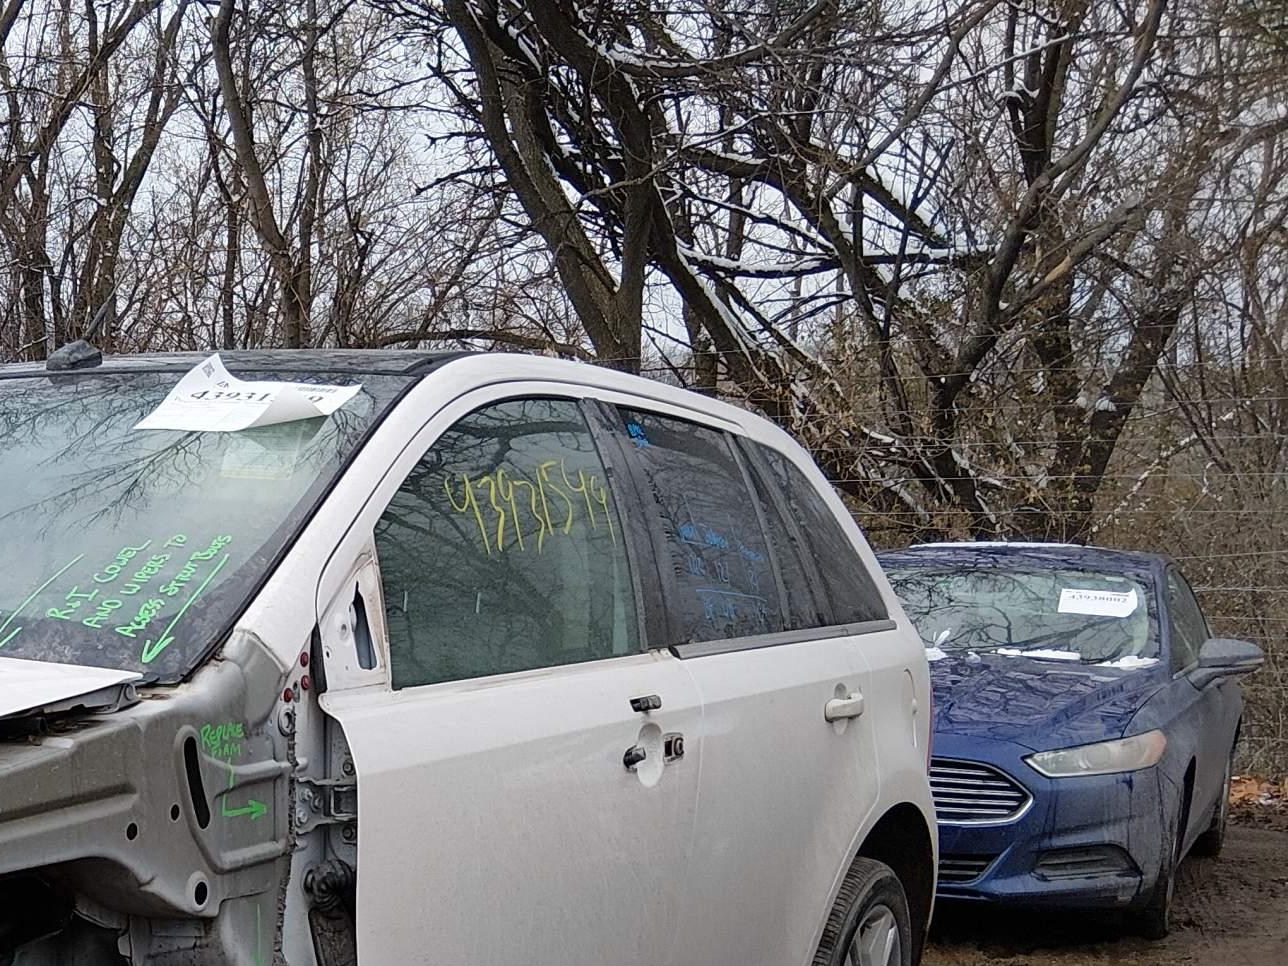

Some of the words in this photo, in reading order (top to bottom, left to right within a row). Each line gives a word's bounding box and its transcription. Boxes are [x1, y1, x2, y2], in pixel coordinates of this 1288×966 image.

[190, 389, 325, 404] 439319
[444, 457, 617, 556] 43931549
[82, 599, 123, 629] AND
[120, 553, 171, 596] WIPERS
[163, 533, 188, 550] TO
